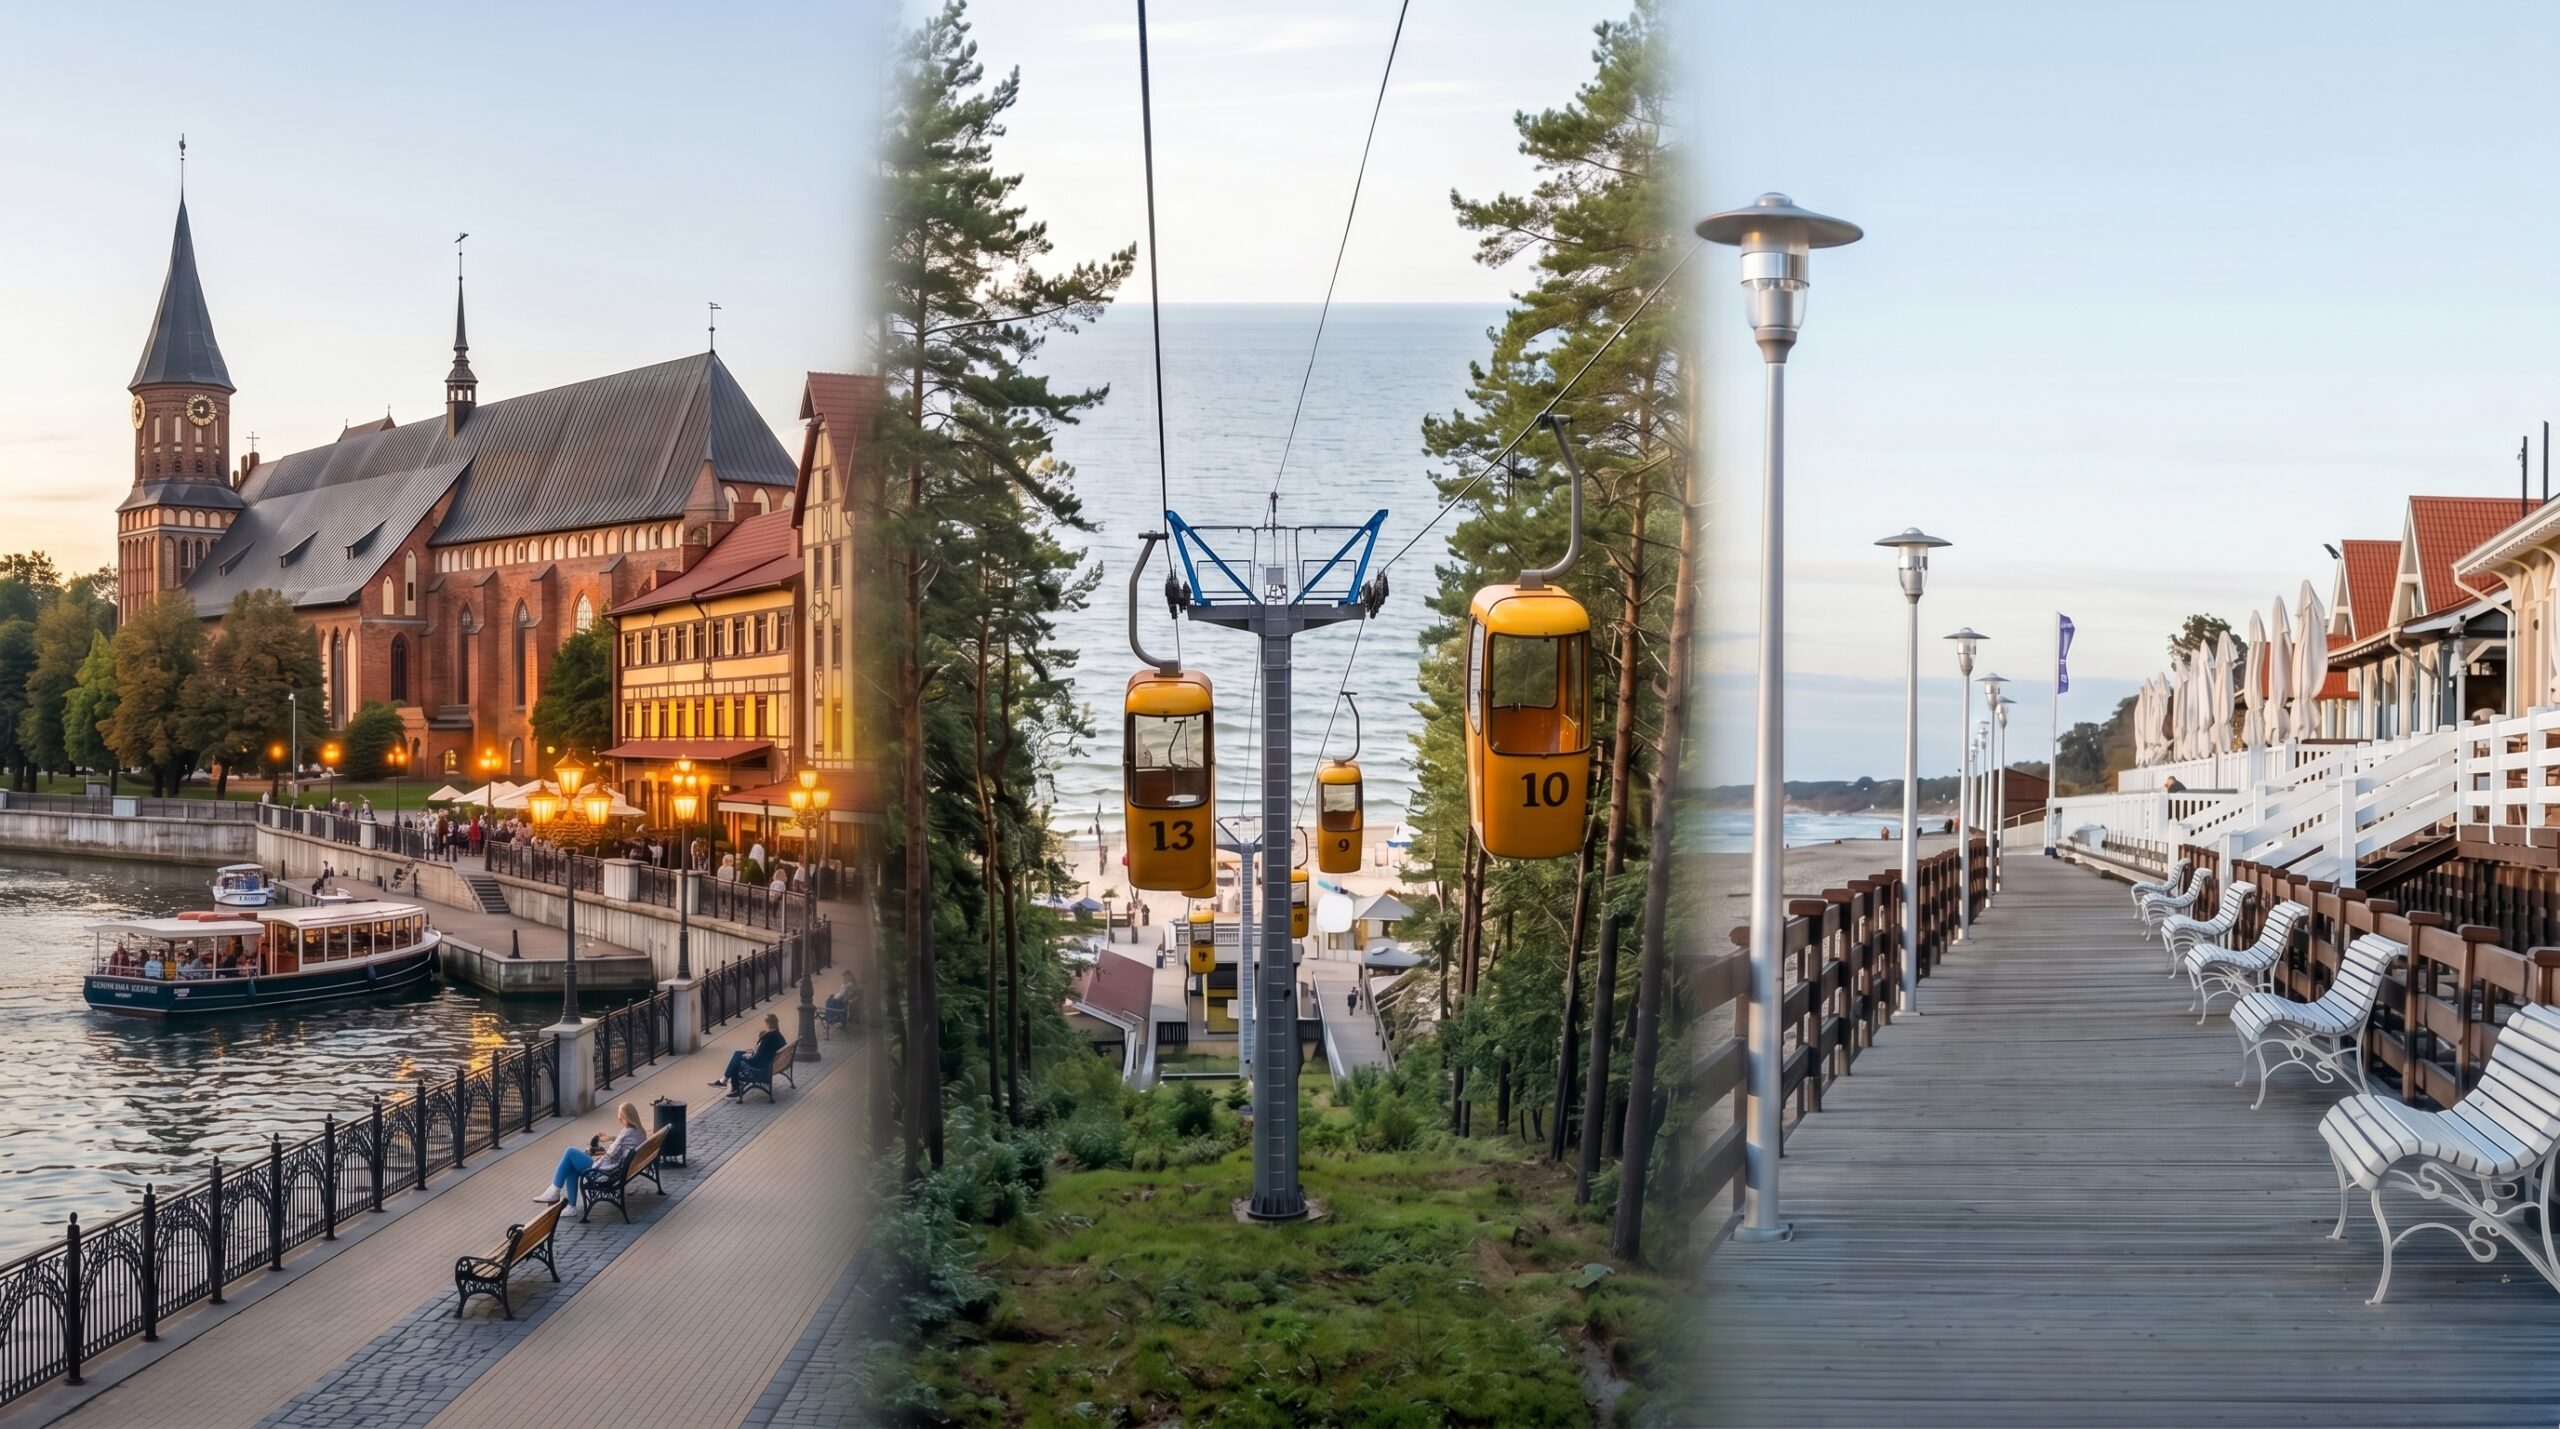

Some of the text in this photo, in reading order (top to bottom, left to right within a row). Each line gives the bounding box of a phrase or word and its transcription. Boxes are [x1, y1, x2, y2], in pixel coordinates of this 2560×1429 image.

[1521, 772, 1569, 807] 10
[1149, 820, 1195, 851] 13
[1338, 838, 1350, 852] 9
